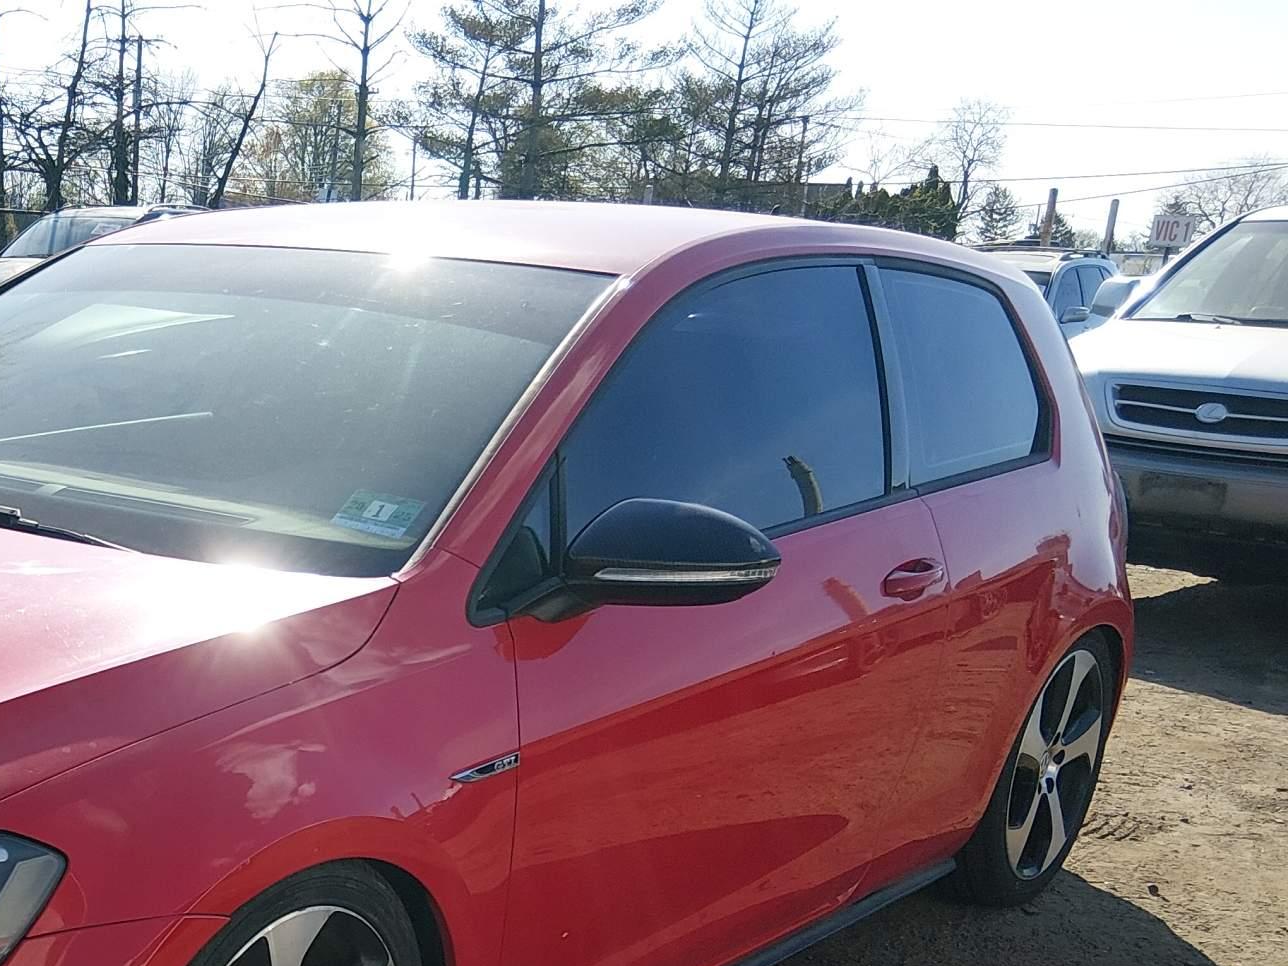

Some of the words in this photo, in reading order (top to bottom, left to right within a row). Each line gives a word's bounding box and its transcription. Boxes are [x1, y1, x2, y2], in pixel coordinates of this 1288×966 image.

[1155, 220, 1180, 242] VIC
[1183, 221, 1192, 243] 1
[494, 756, 516, 772] GTI
